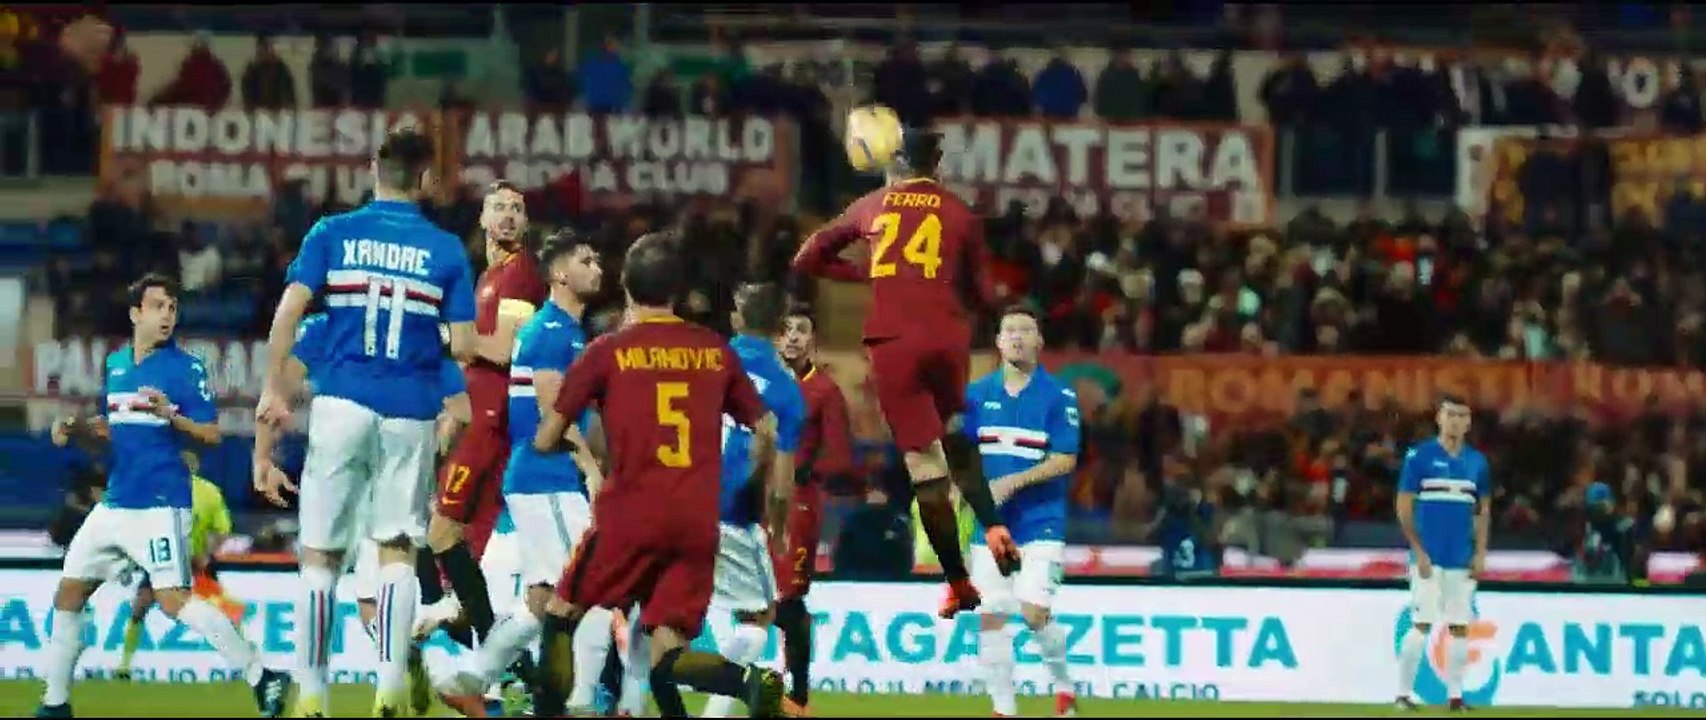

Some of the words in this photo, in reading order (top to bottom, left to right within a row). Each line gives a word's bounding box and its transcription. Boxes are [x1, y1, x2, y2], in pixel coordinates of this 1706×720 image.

[466, 112, 594, 158] ARAB
[606, 115, 774, 162] WORLD
[938, 124, 1259, 188] MATERA
[869, 212, 943, 279] 24
[364, 276, 407, 361] 11
[656, 381, 692, 468] 5
[445, 463, 471, 494] 17
